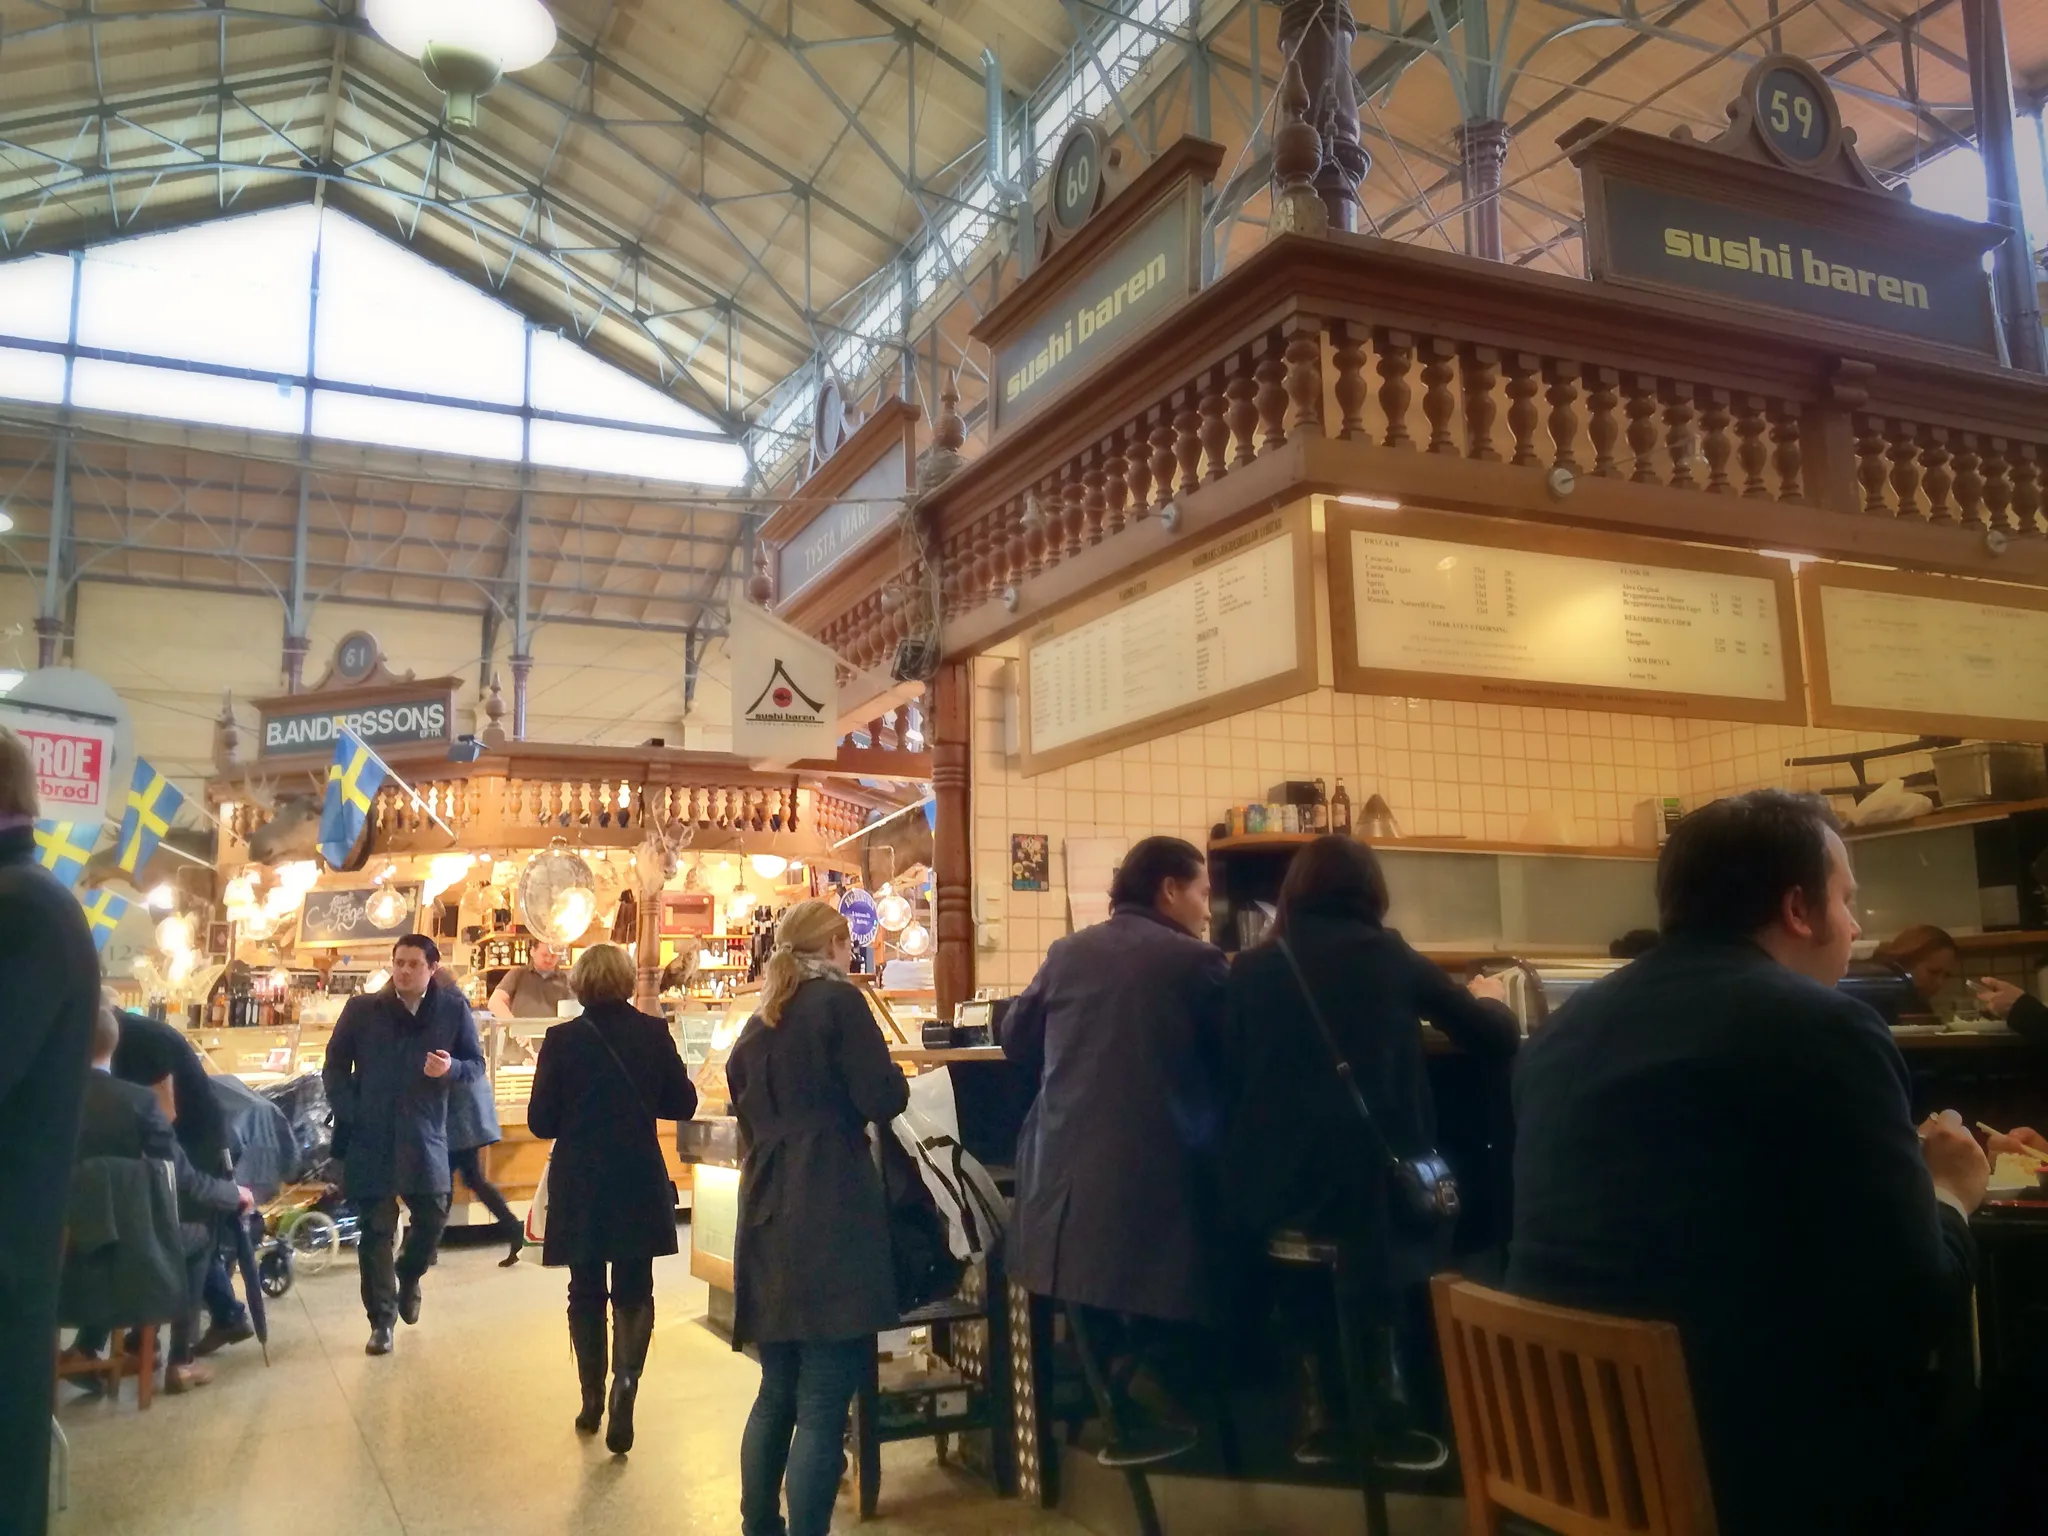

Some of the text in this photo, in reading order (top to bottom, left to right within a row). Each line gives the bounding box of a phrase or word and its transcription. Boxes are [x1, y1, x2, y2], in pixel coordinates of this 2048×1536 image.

[1770, 90, 1813, 139] 59
[1066, 155, 1090, 208] 60
[1664, 227, 1930, 310] sushi baren
[1006, 253, 1166, 403] sushi baren
[805, 504, 870, 571] TYSTA MARI
[345, 647, 365, 668] 61
[755, 712, 816, 721] sushi baren
[36, 779, 89, 799] brød
